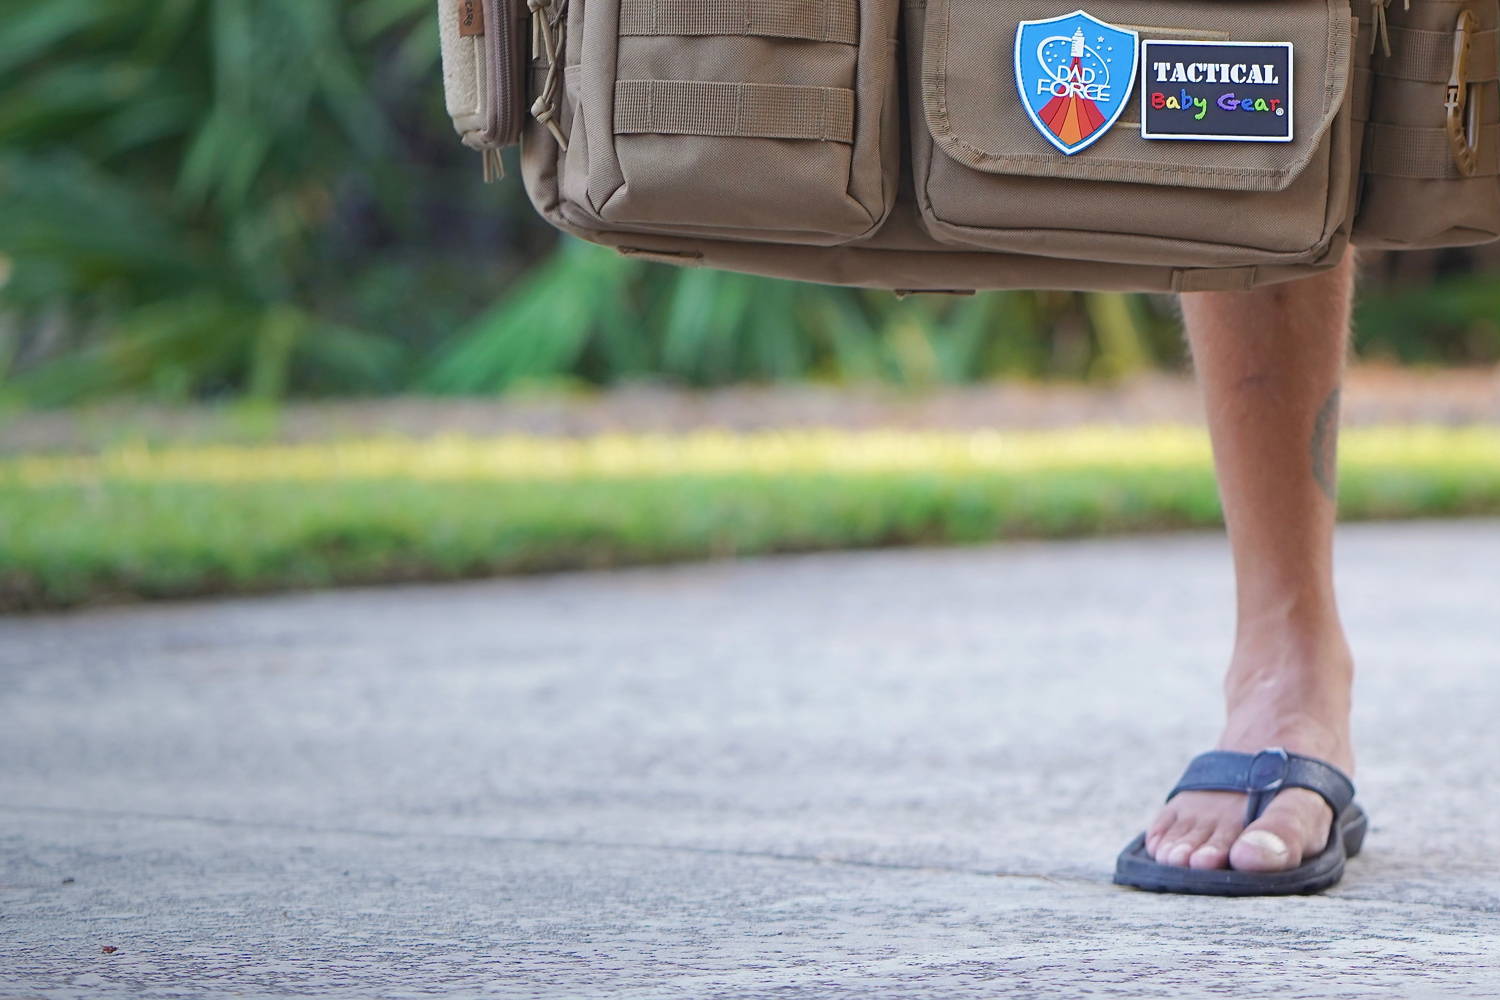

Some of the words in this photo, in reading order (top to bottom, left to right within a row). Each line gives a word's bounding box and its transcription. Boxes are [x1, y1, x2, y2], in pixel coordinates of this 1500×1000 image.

[1057, 64, 1096, 84] DAD
[1153, 62, 1279, 84] TACTICAL
[1036, 78, 1111, 102] FORCE
[1151, 89, 1207, 120] Baby
[1216, 92, 1281, 113] Gear
